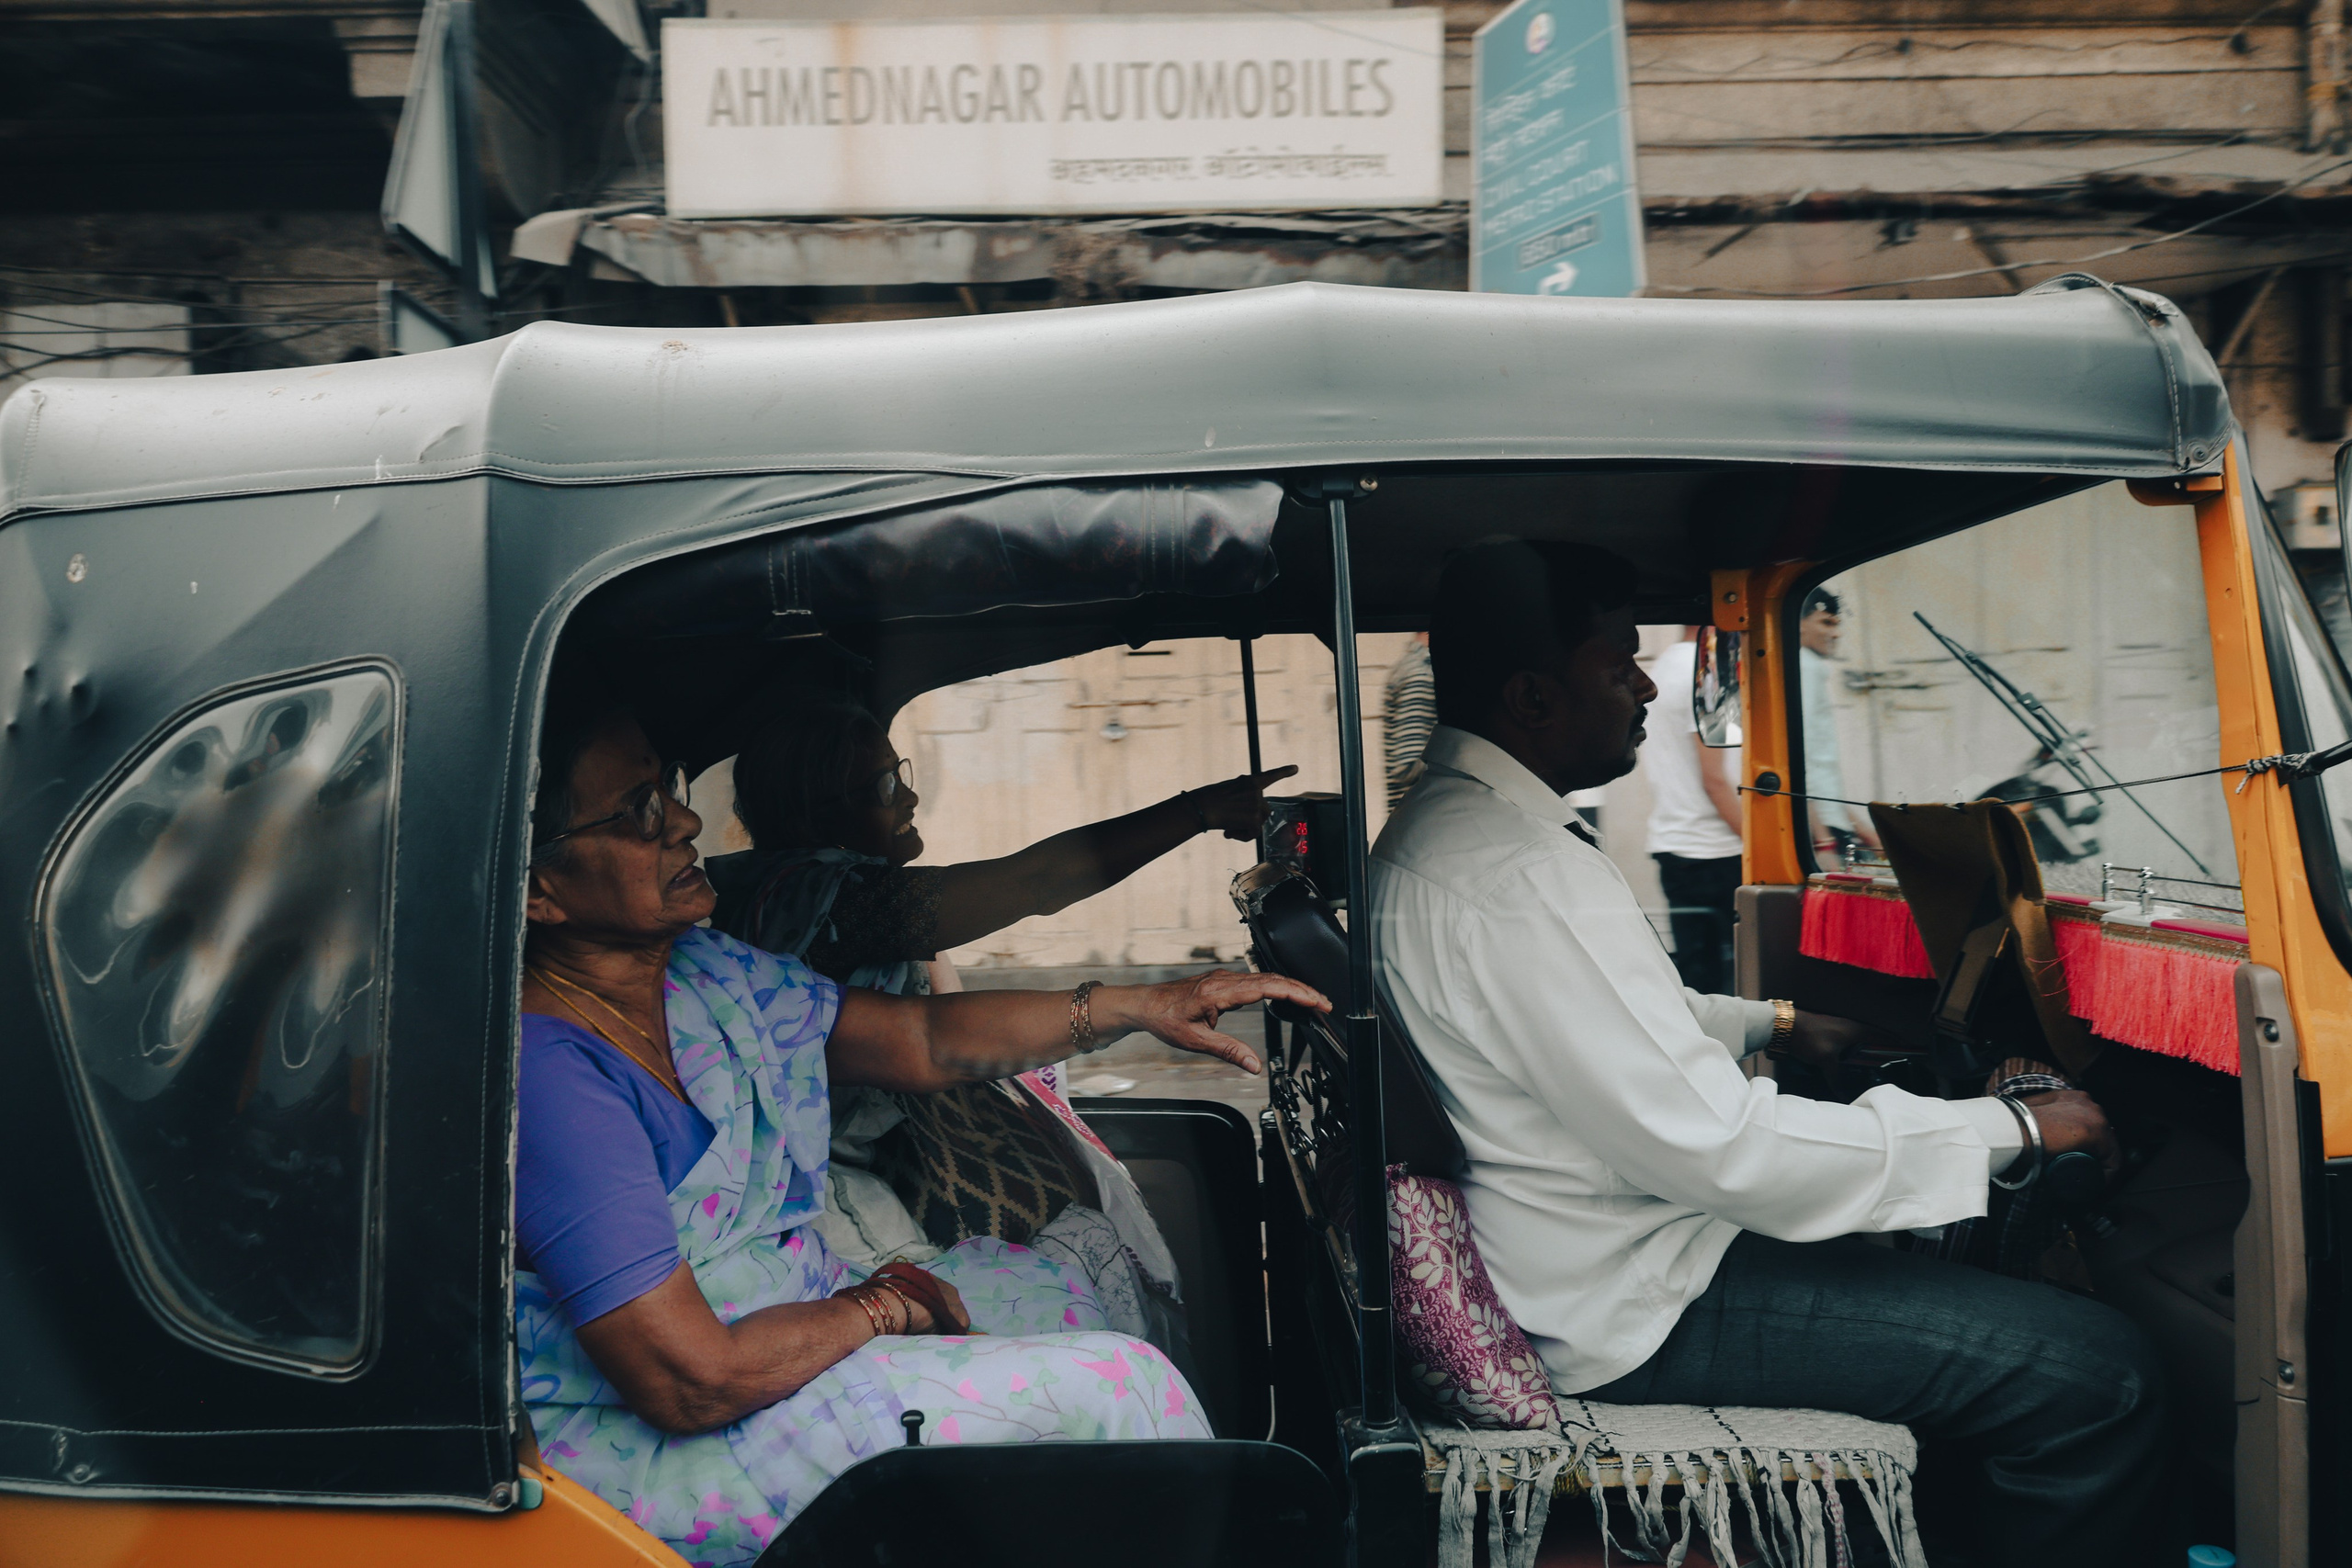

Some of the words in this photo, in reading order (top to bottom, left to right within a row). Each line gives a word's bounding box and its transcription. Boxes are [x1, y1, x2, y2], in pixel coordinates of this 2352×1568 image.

[707, 64, 1046, 127] AHMEDNAGAR
[1059, 59, 1394, 122] AUTOMOBILES
[1538, 162, 1619, 213] STATION
[1296, 822, 1307, 835] 26
